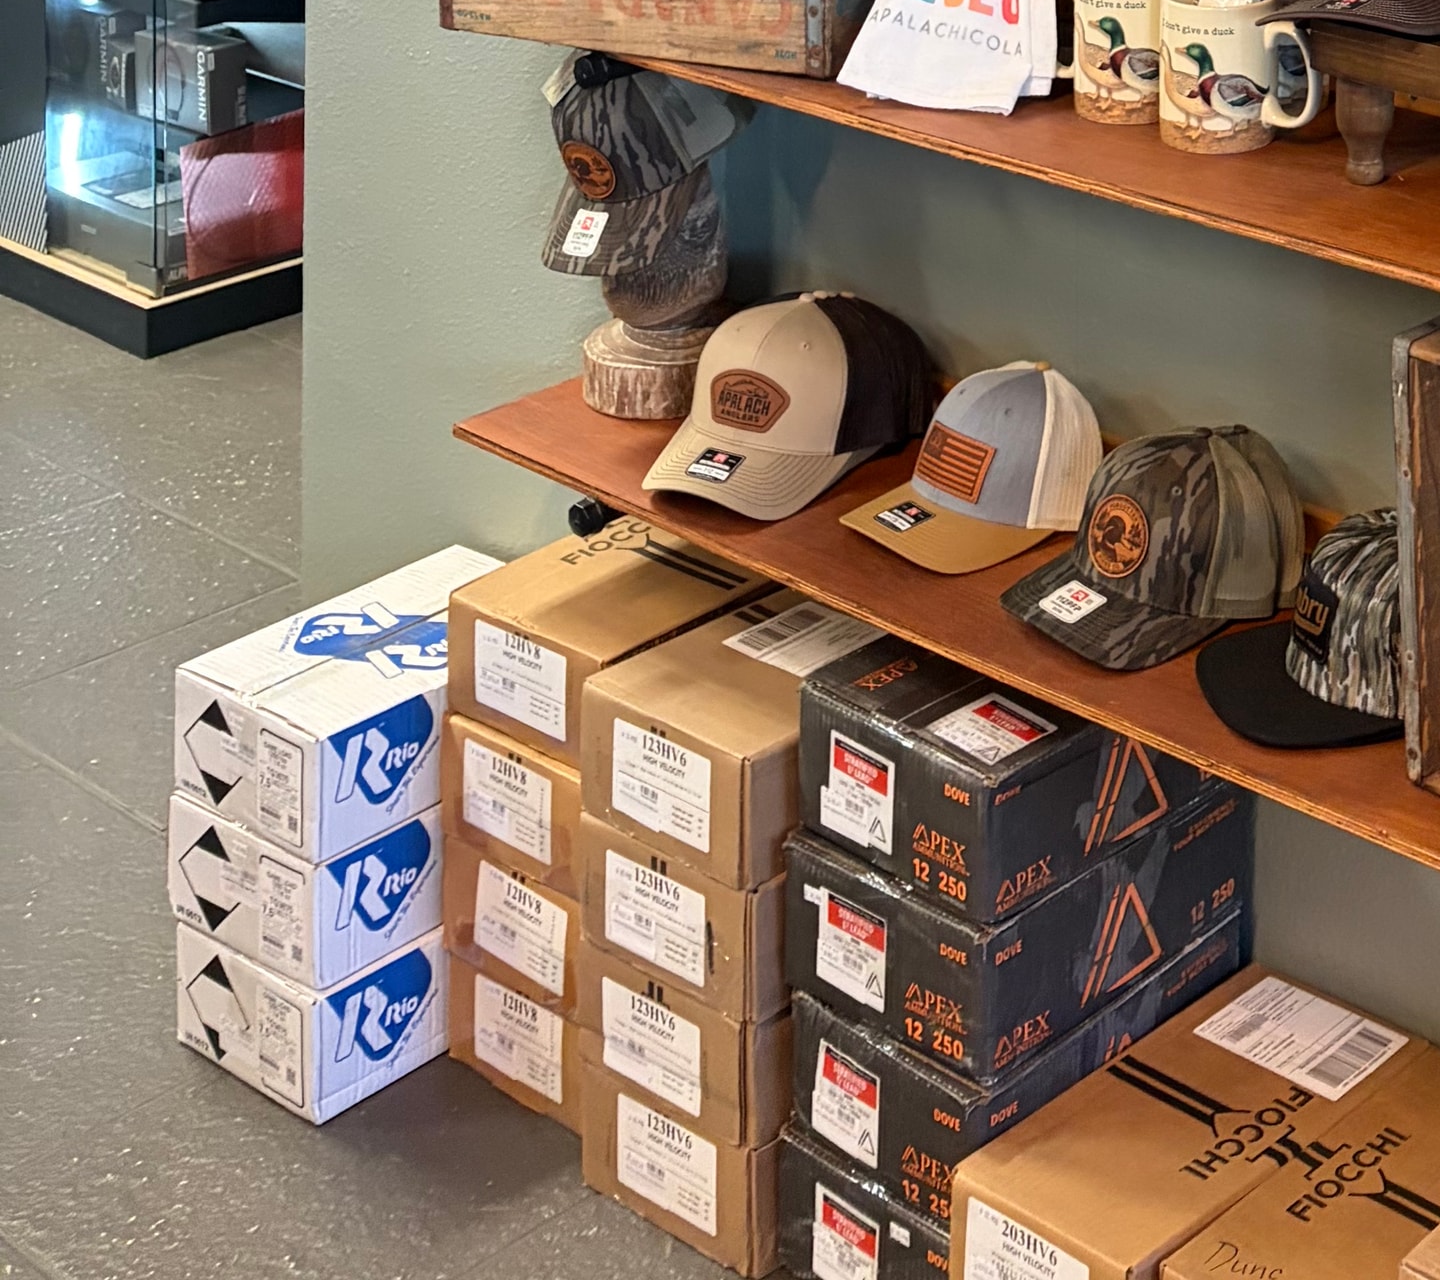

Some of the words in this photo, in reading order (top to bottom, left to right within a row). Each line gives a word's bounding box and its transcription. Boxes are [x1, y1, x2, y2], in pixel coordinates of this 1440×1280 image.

[1095, 0, 1114, 9] give
[1124, 0, 1146, 9] duck
[868, 7, 1023, 58] APALACHICOLA
[1182, 25, 1201, 36] give
[1211, 27, 1235, 36] duck
[194, 50, 207, 122] GARMIN
[717, 389, 771, 417] APALACH
[504, 632, 542, 662] 12HV8
[385, 742, 419, 771] Rio
[642, 734, 687, 767] 123HV6
[491, 755, 528, 786] 12HV8
[944, 783, 970, 806] DOVE
[912, 822, 967, 865] APEX
[384, 867, 418, 896] Rio
[633, 867, 681, 902] 123HV6
[912, 858, 930, 882] 12
[938, 871, 967, 902] 250
[995, 855, 1053, 903] APEX
[505, 881, 543, 915] 12HV8
[940, 943, 968, 966] DOVE
[994, 939, 1023, 966] DOVE
[385, 996, 419, 1027] Rio
[501, 991, 538, 1024] 12HV8
[630, 995, 676, 1032] 123HV6
[905, 982, 963, 1024] APEX
[904, 1017, 924, 1042] 12
[932, 1029, 964, 1061] 250
[994, 1010, 1051, 1061] APEX
[933, 1108, 961, 1132] DOVE
[989, 1100, 1019, 1127] DOVE
[647, 1113, 693, 1151] 123HV6
[1179, 1085, 1314, 1180] FIOCCHI
[902, 1144, 954, 1184] APEX
[1286, 1126, 1412, 1222] FIOCCHI
[902, 1180, 921, 1203] 12
[929, 1193, 952, 1218] 25
[926, 1249, 950, 1272] DOV
[1001, 1220, 1058, 1267] 203HV6
